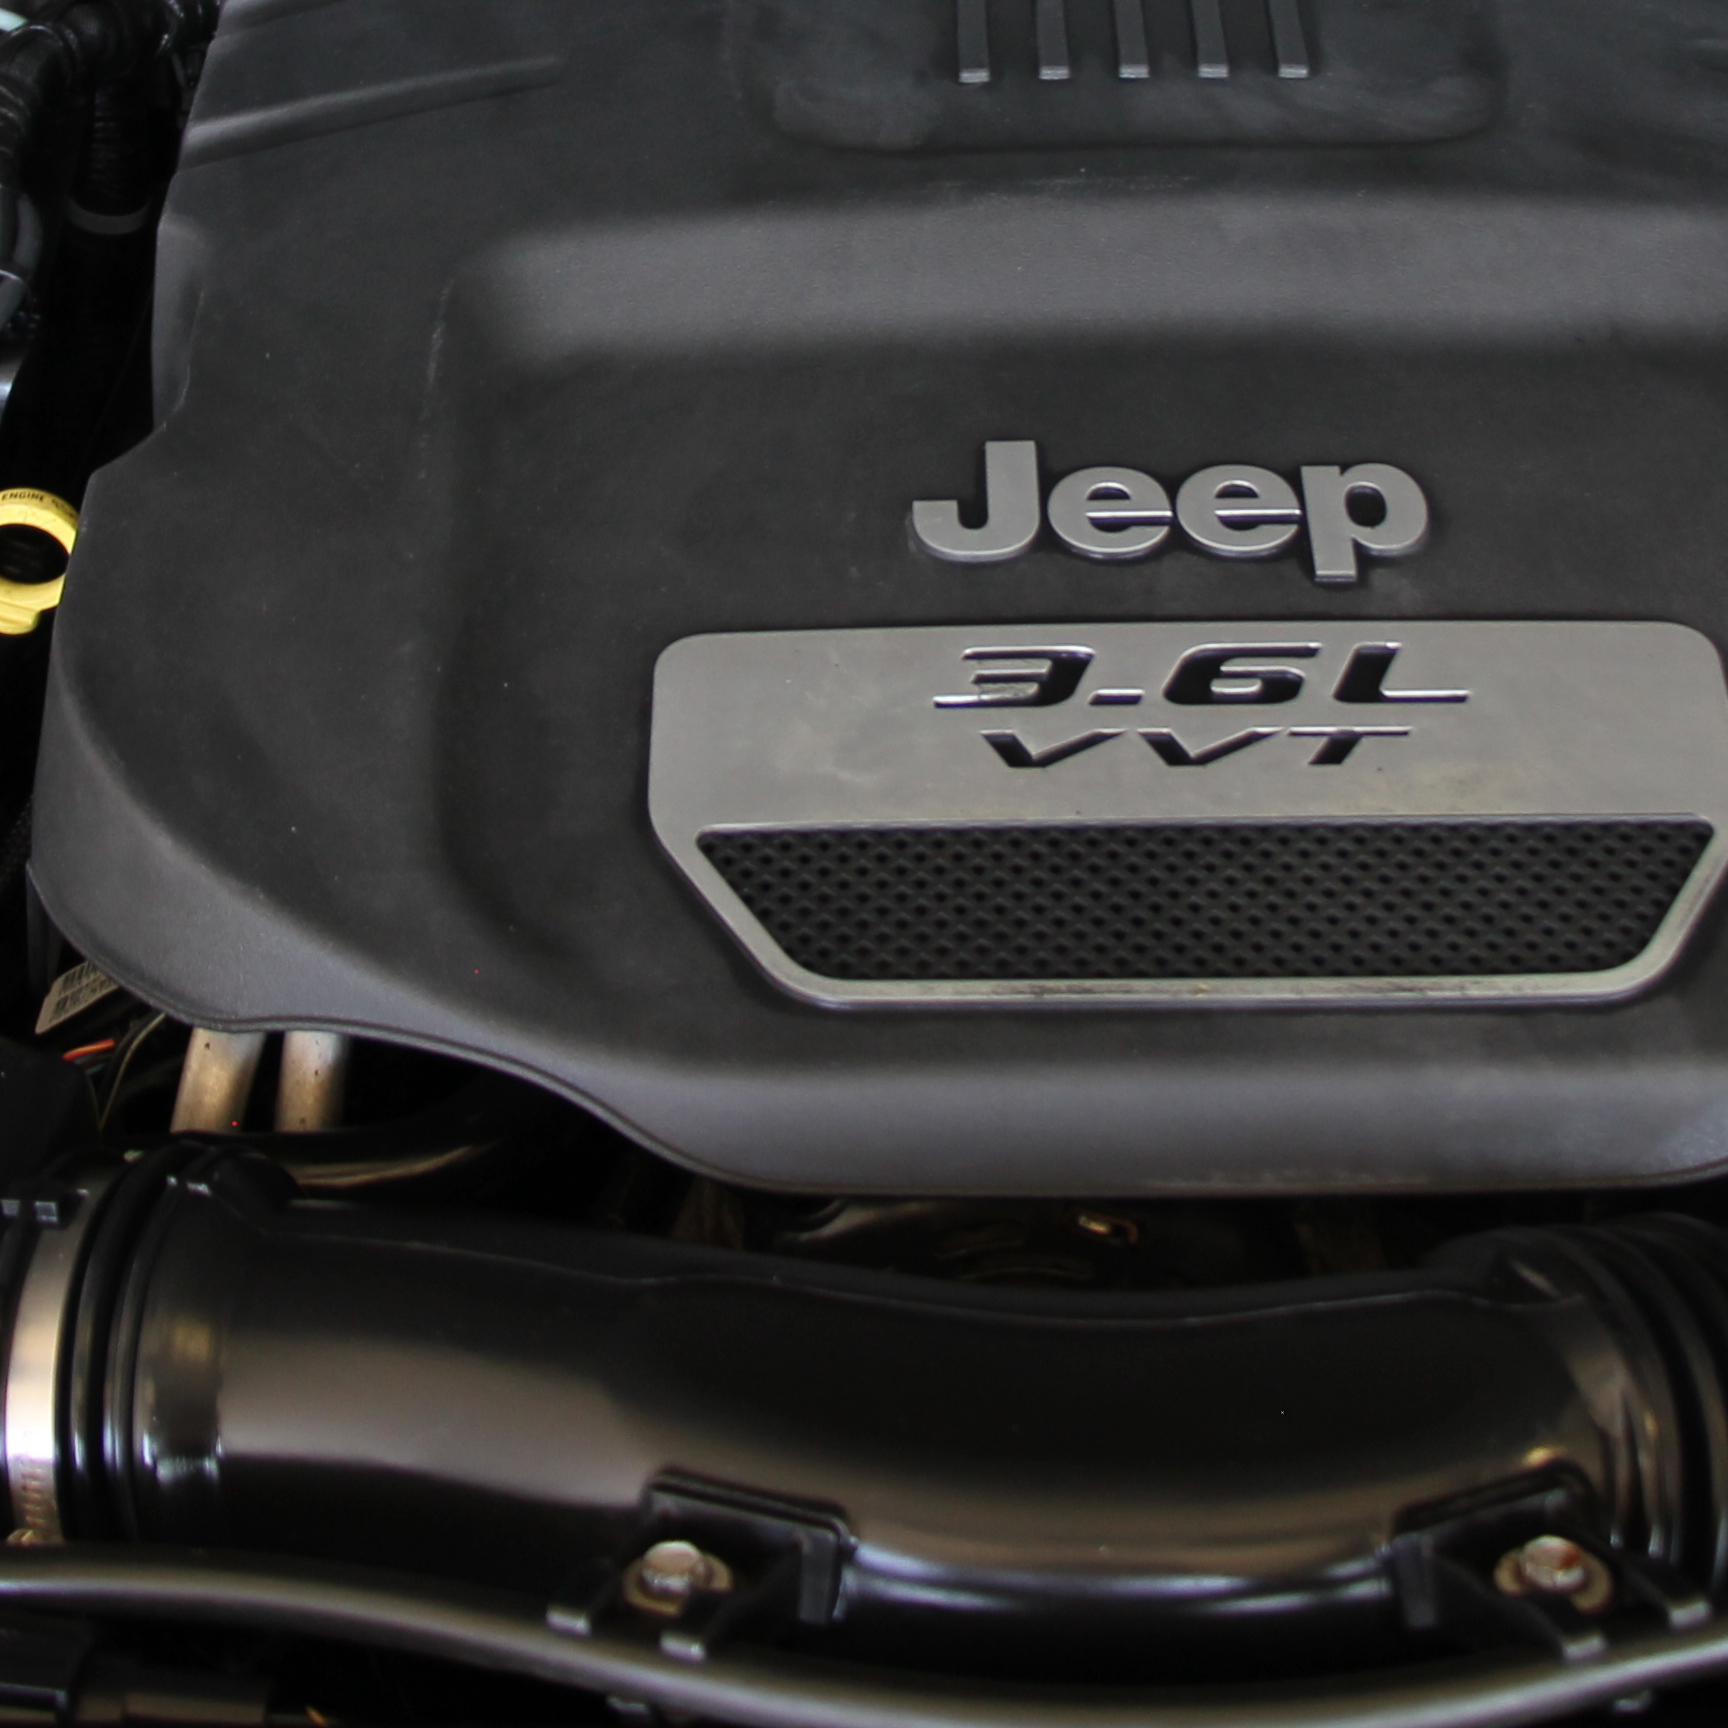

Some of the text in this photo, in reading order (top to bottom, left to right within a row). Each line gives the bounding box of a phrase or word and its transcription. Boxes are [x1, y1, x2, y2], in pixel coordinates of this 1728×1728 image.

[1, 491, 44, 502] ENGINE
[911, 439, 1430, 583] Jeep
[933, 640, 1471, 708] 3.6L
[979, 725, 1414, 769] VVT
